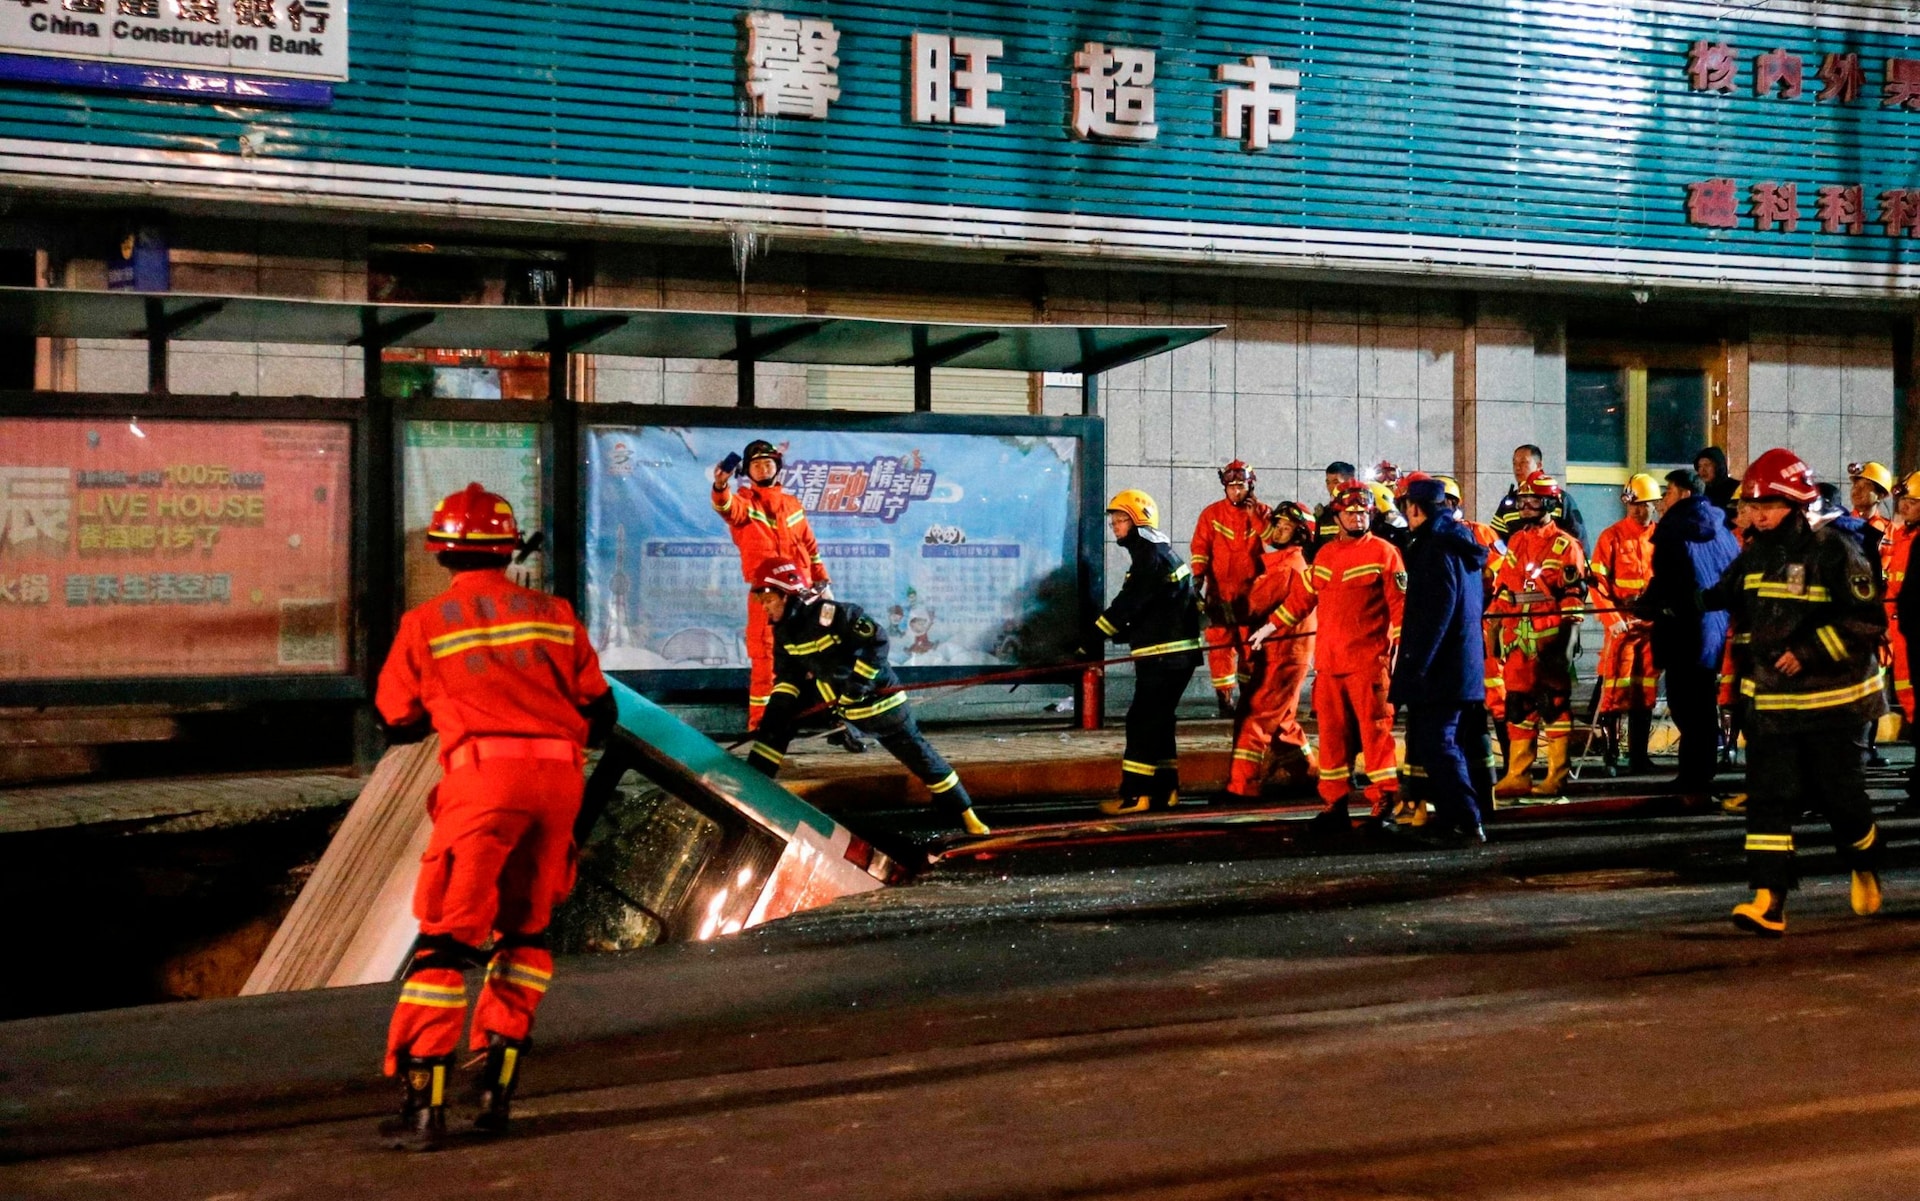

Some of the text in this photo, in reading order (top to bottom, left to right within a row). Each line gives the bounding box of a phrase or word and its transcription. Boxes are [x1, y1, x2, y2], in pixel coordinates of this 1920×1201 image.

[29, 12, 324, 56] China Construction Bank
[745, 11, 1301, 150] 馨旺超市
[78, 493, 266, 519] LIVE HOUSE
[818, 464, 869, 513] 融
[861, 489, 905, 520] 西宁
